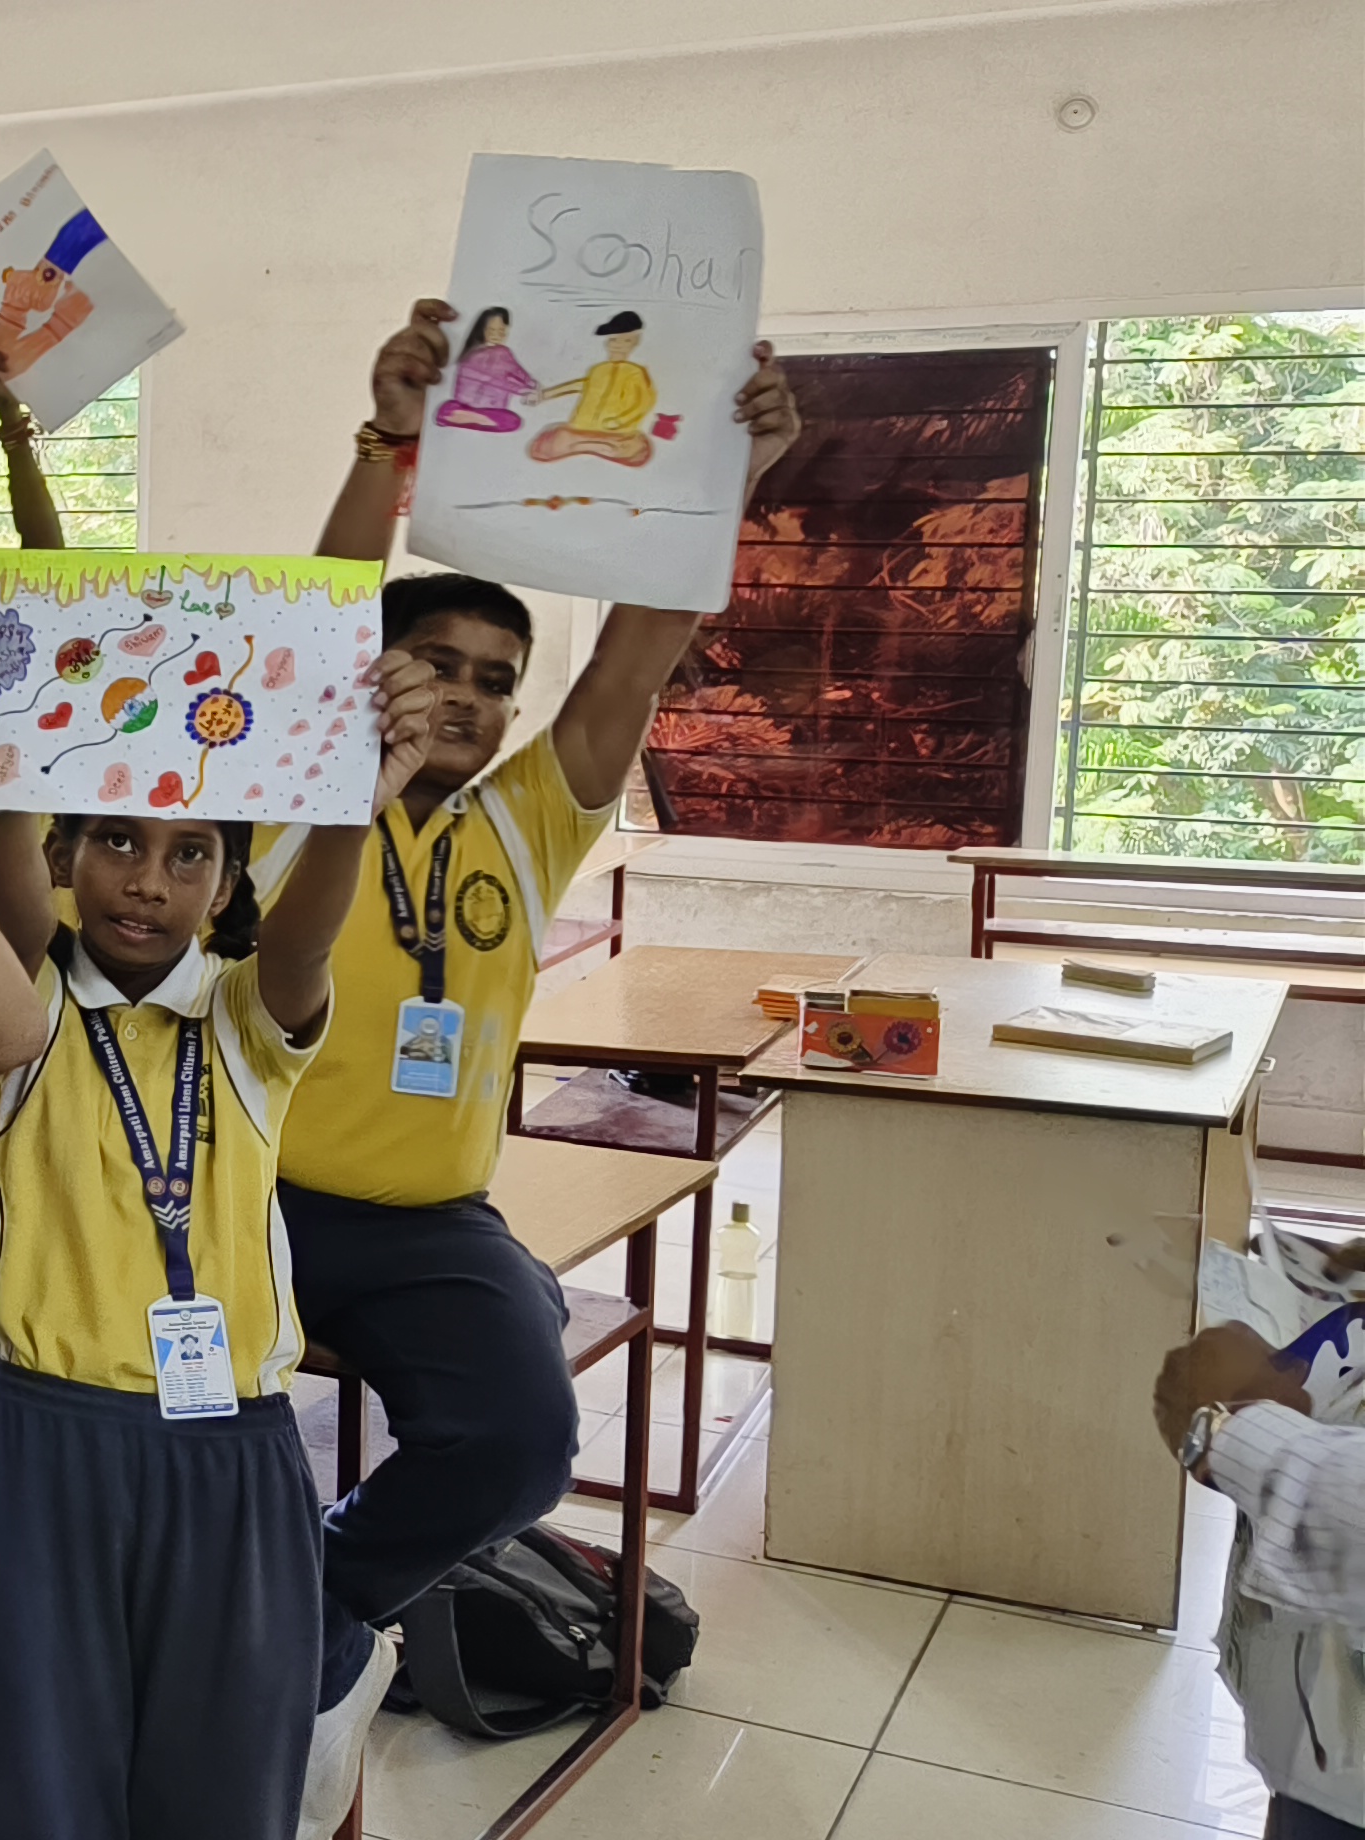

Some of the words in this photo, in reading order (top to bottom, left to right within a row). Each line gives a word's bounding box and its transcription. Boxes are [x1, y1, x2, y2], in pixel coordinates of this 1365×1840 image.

[103, 1042, 126, 1084] Citizens
[180, 1040, 197, 1082] Citizens
[119, 1084, 138, 1115] Lions
[178, 1084, 193, 1112] Lions
[128, 1115, 156, 1169] Amarpati
[175, 1115, 192, 1170] Amarpati
